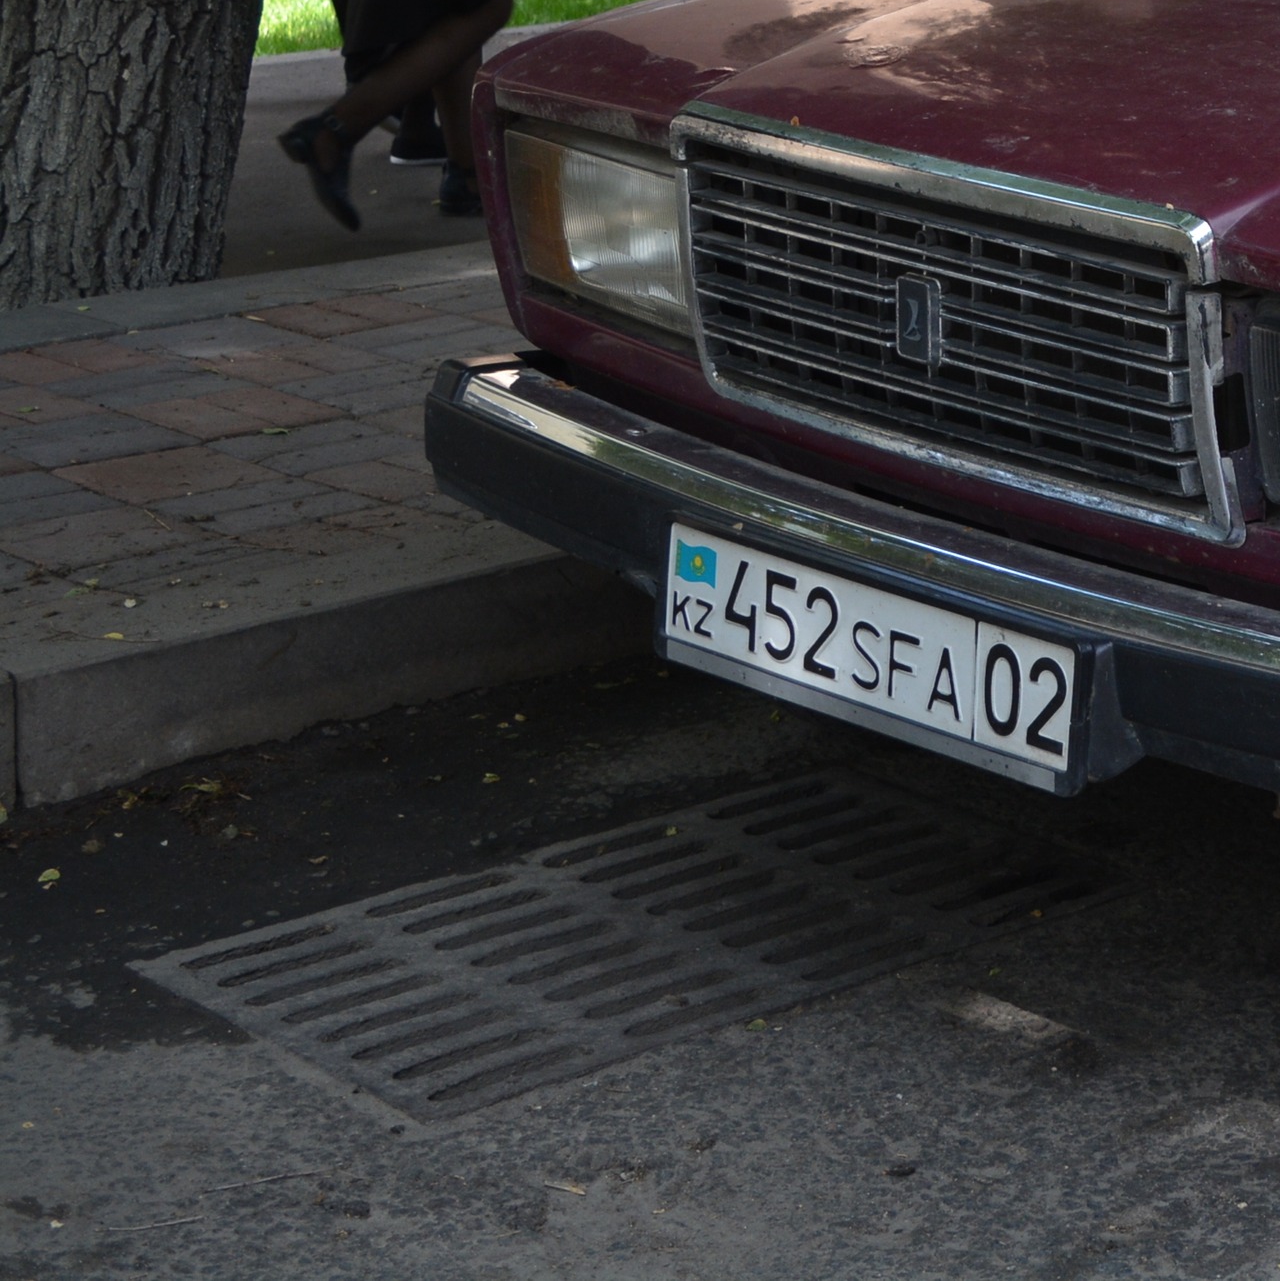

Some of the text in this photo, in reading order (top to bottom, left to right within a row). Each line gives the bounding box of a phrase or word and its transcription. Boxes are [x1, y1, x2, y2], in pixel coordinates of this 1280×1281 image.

[672, 560, 1068, 756] KZ 452SFA 02
